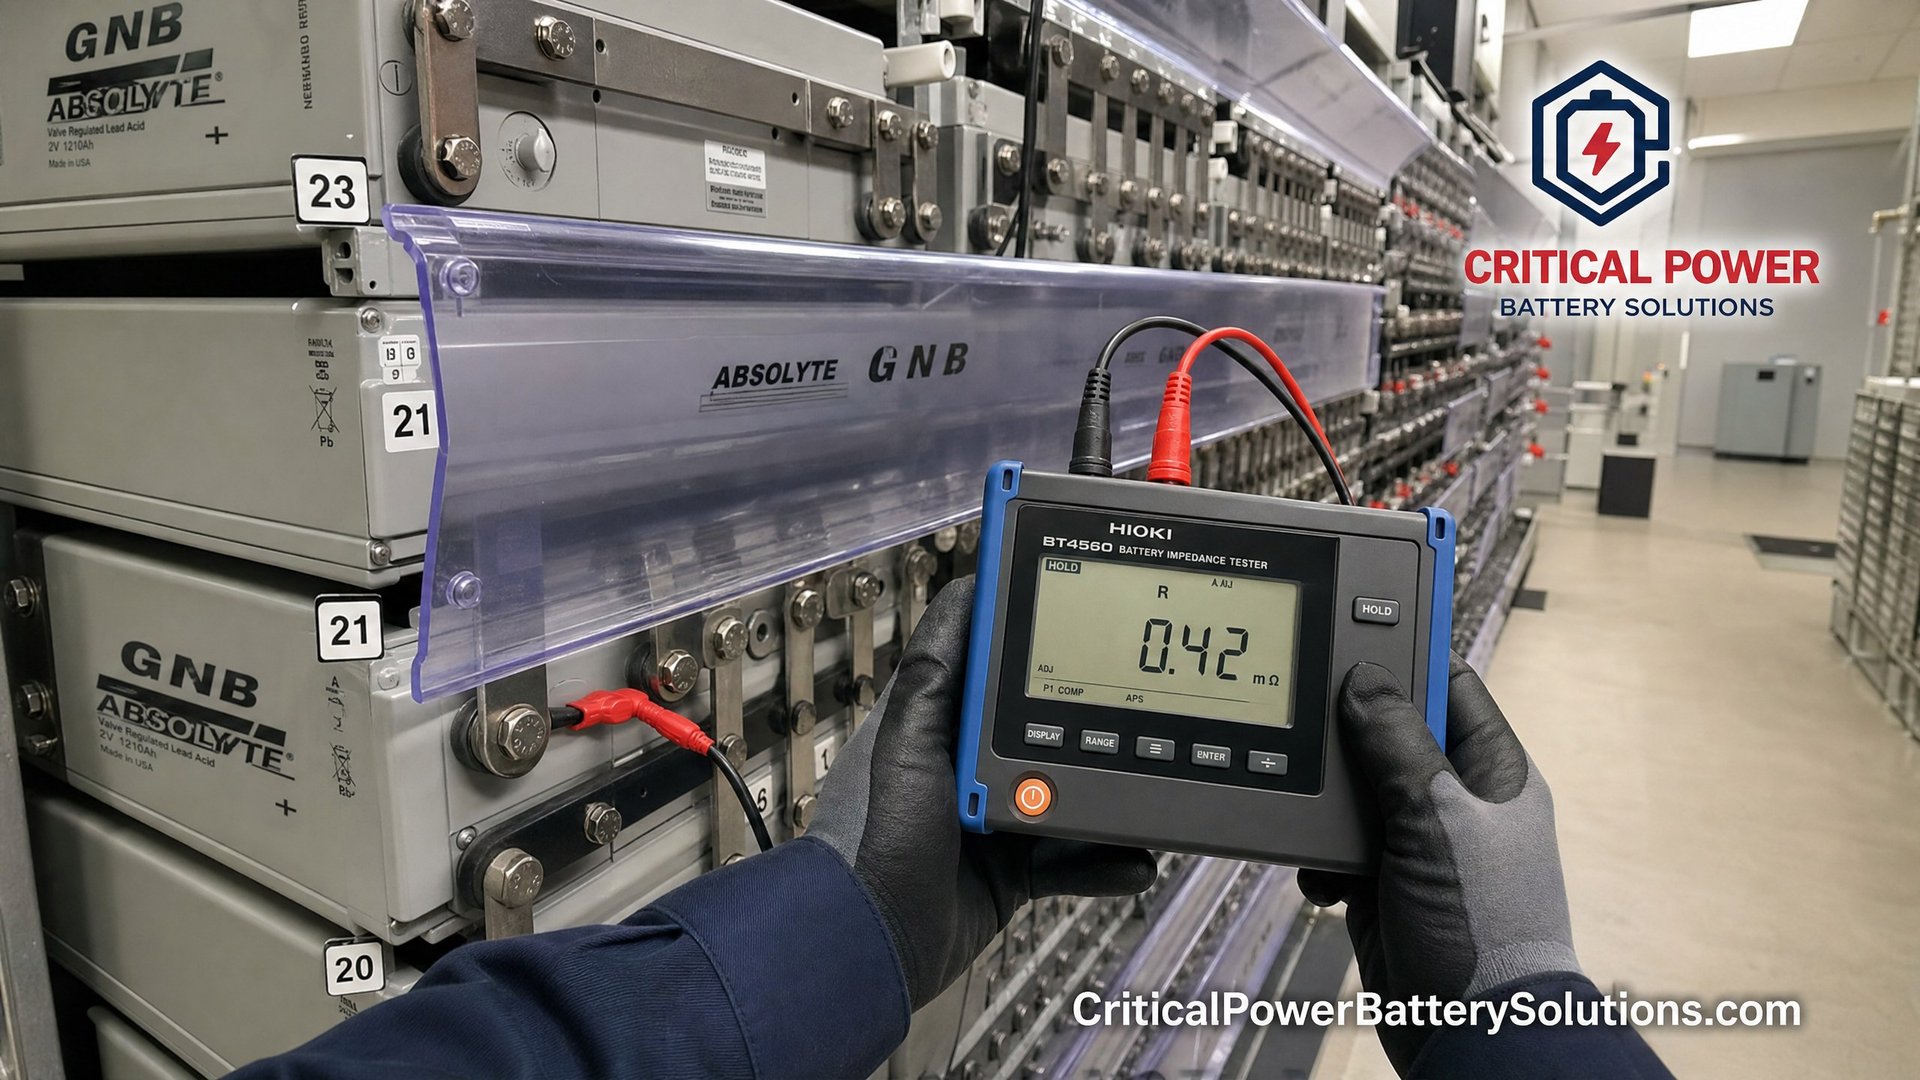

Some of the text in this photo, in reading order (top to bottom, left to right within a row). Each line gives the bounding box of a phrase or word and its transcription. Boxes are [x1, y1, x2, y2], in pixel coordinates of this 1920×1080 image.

[66, 2, 183, 62] GNB
[47, 121, 145, 138] Valve Regulated Lead Acid
[48, 141, 94, 152] 2V 1210Ah
[48, 158, 91, 169] Made in USA
[308, 174, 356, 209] 23
[712, 359, 838, 389] ABSOLYTE
[393, 403, 430, 438] 21
[320, 435, 334, 448] Pb
[1109, 522, 1172, 540] HIOKI
[1043, 536, 1268, 570] BT4560 BATTERY IMPEDANCE TESTER
[1048, 560, 1079, 573] HOLD
[1157, 585, 1169, 599] R
[1362, 603, 1392, 617] HOLD
[330, 614, 368, 646] 21
[1138, 618, 1249, 681] 0.42
[121, 640, 259, 708] GNB
[1037, 663, 1054, 674] ADJ
[1043, 684, 1084, 696] P1 COMP
[1125, 693, 1144, 703] APS
[97, 716, 215, 768] Valve Regulated Lead Acid
[100, 729, 157, 759] 2V 1210Ah
[1027, 729, 1061, 742] DISPLAY
[1085, 736, 1115, 748] RANGE
[100, 744, 154, 772] Made in USA
[1196, 750, 1226, 762] ENTER
[335, 954, 374, 983] 20
